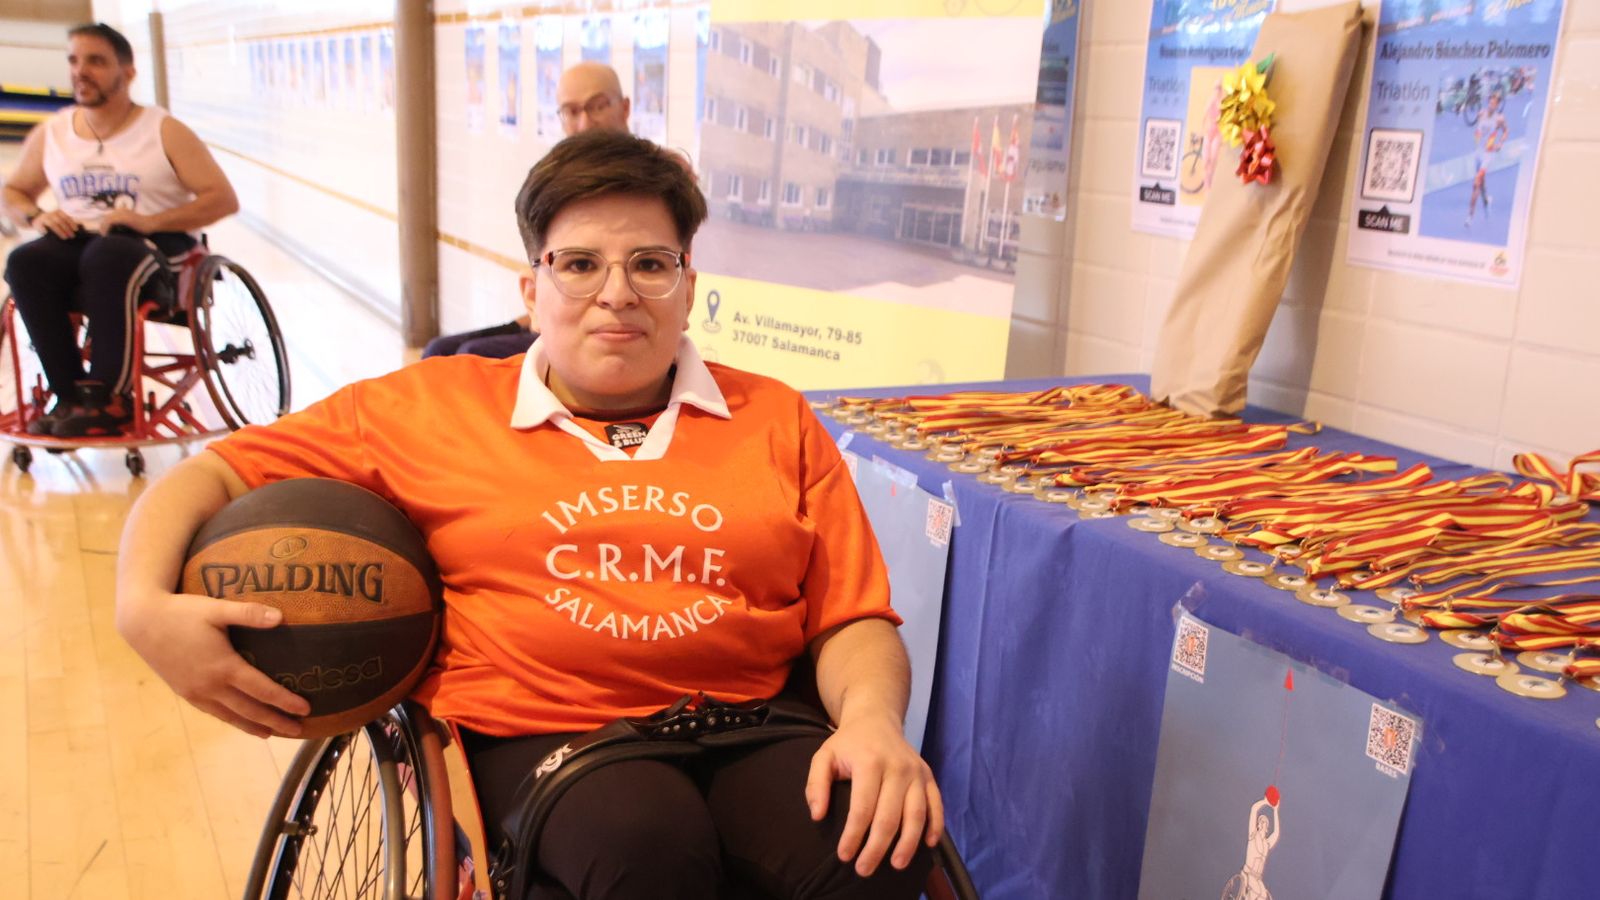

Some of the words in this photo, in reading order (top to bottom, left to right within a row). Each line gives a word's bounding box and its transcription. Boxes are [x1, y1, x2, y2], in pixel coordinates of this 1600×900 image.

[1379, 41, 1433, 63] Alejandro
[1436, 38, 1483, 58] Sánchez
[1487, 40, 1550, 59] Palomero
[1377, 80, 1430, 101] Triatlón
[1364, 214, 1389, 229] SCAN
[1390, 216, 1404, 231] ME
[732, 330, 768, 347] 37007
[772, 336, 841, 361] Salamanca
[733, 311, 750, 324] Av.
[755, 315, 822, 340] Villamayor,
[827, 327, 863, 346] 79-85
[611, 430, 646, 441] GREEN
[541, 485, 723, 535] IMSERSO
[545, 543, 727, 587] C.R.M.F.
[200, 562, 384, 606] SPALDING
[545, 587, 733, 642] SALAMANCA
[276, 656, 384, 693] ndesa
